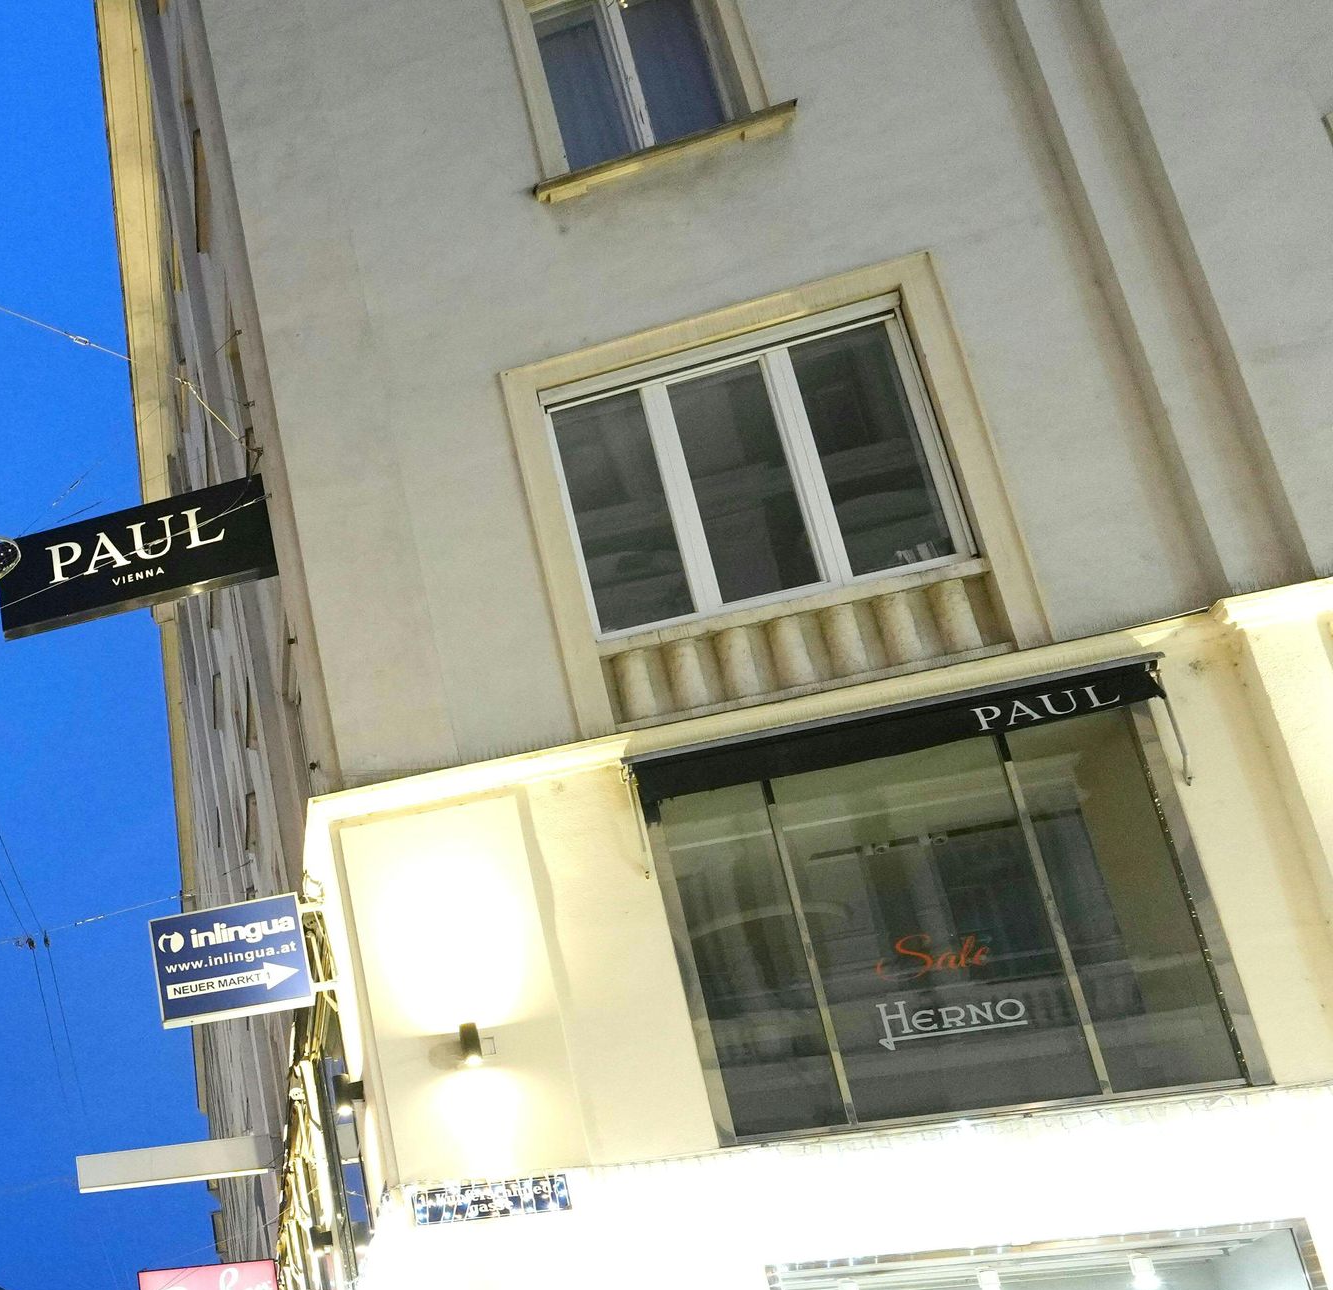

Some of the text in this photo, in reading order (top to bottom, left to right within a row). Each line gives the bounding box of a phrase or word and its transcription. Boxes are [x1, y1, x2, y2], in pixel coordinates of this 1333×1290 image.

[45, 507, 225, 584] PAUL
[111, 566, 165, 586] VIENNA
[969, 684, 1121, 731] PAUL
[189, 915, 296, 949] inlingua
[165, 940, 297, 974] www.inlingua.at
[875, 934, 989, 981] Sale
[173, 980, 216, 997] NEUER
[217, 972, 261, 989] MARKT
[876, 998, 1028, 1050] HERNO
